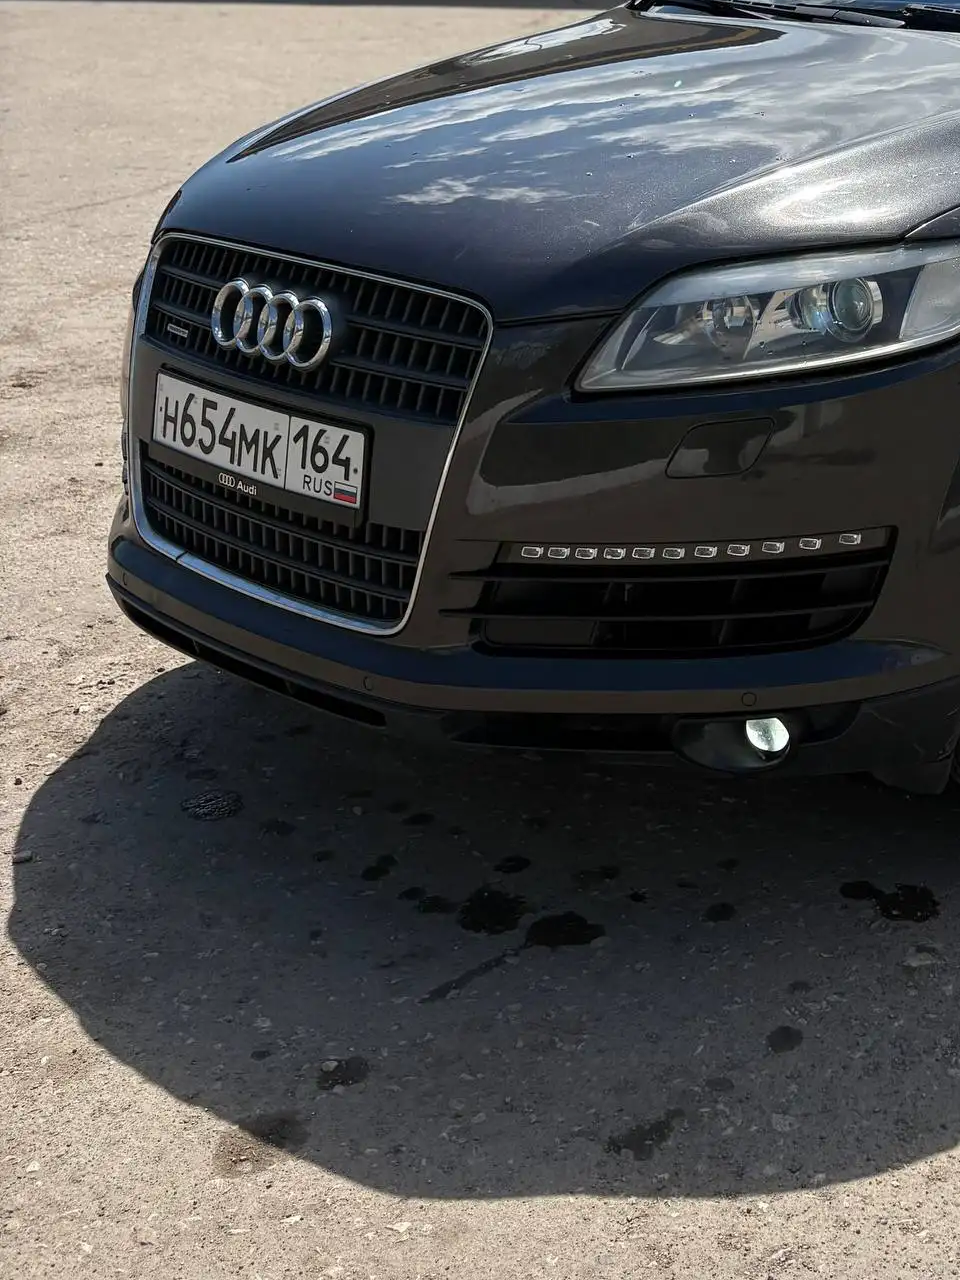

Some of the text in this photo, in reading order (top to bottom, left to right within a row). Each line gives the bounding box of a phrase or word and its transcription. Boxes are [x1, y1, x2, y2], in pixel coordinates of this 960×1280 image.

[293, 425, 350, 481] 164
[237, 480, 257, 496] Audi
[303, 475, 332, 497] RUS
